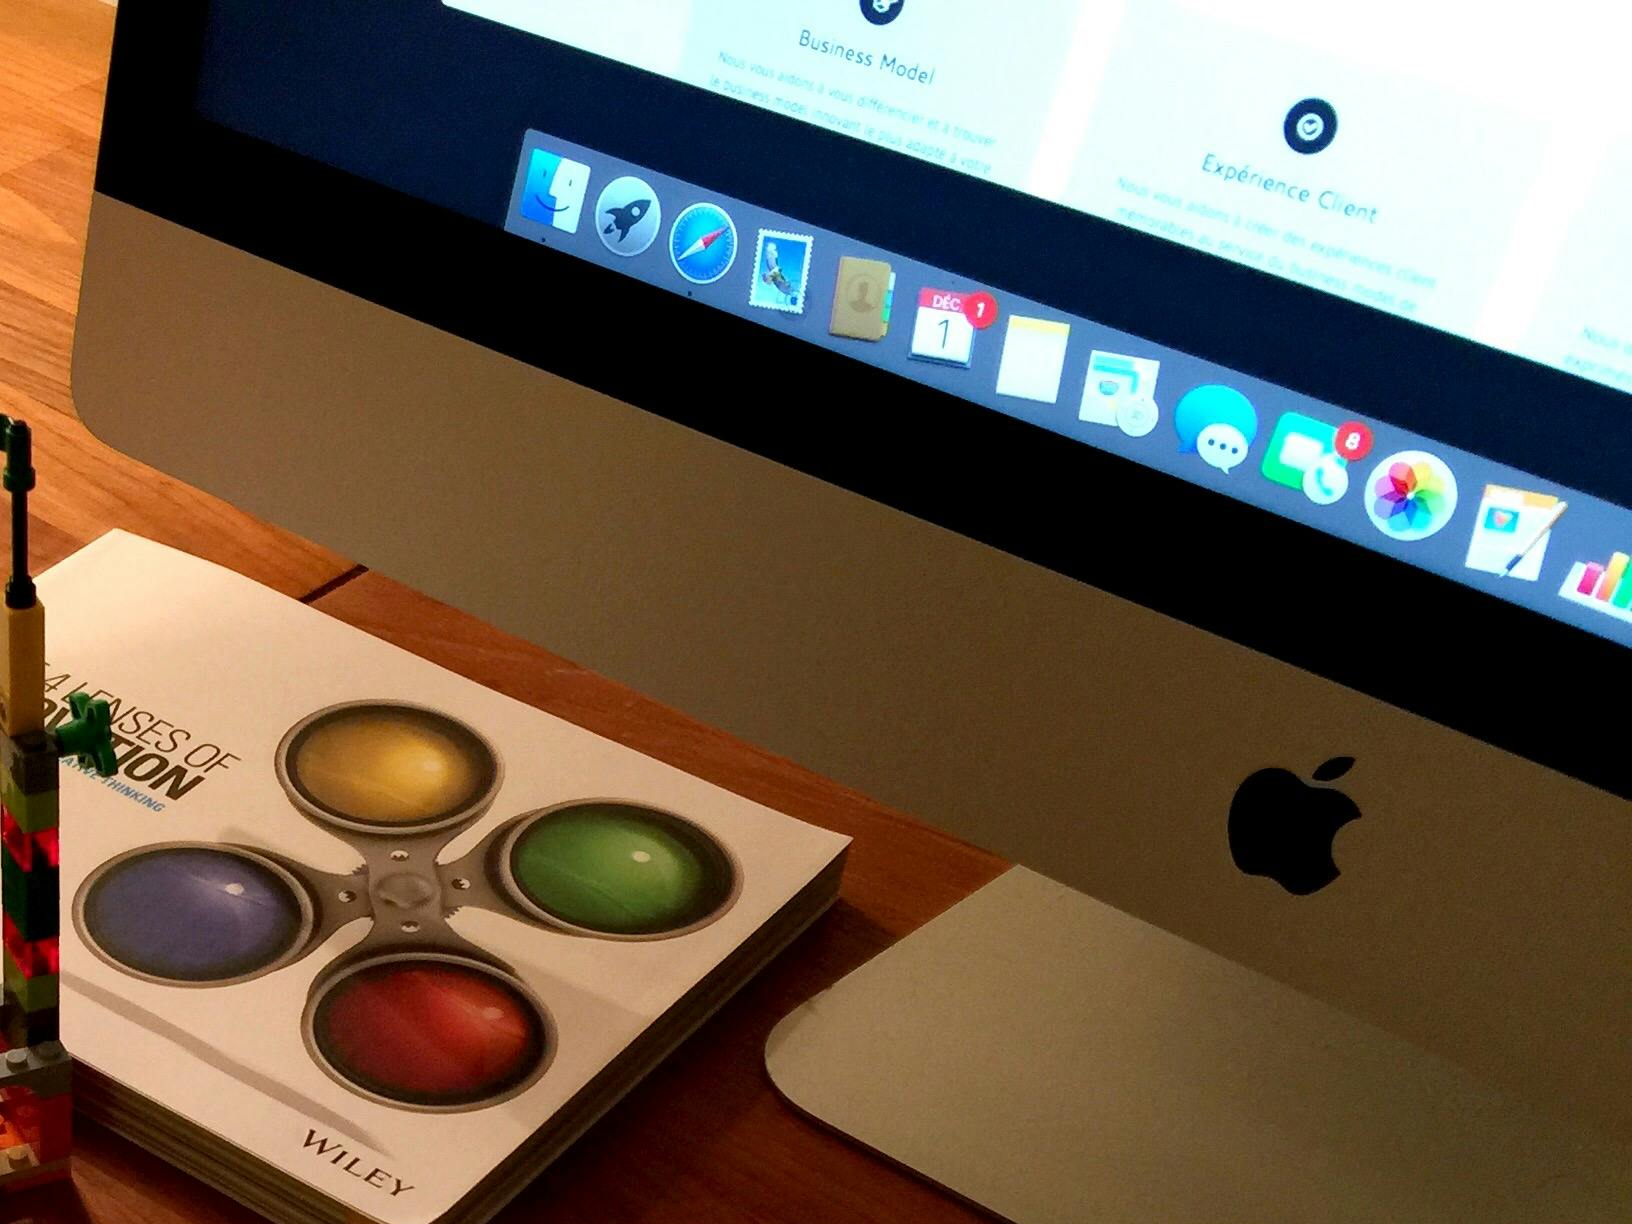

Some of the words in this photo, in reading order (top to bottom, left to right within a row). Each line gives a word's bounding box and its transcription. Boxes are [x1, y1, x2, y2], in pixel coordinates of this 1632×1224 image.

[798, 30, 873, 67] Business
[879, 54, 937, 86] Model
[1202, 153, 1310, 202] Expérience
[1317, 190, 1378, 224] Client
[976, 302, 985, 319] 1
[937, 319, 950, 350] 1
[1344, 431, 1360, 450] 8
[184, 743, 242, 773] OF
[101, 776, 166, 812] THINKING
[303, 1128, 415, 1197] WILEY
